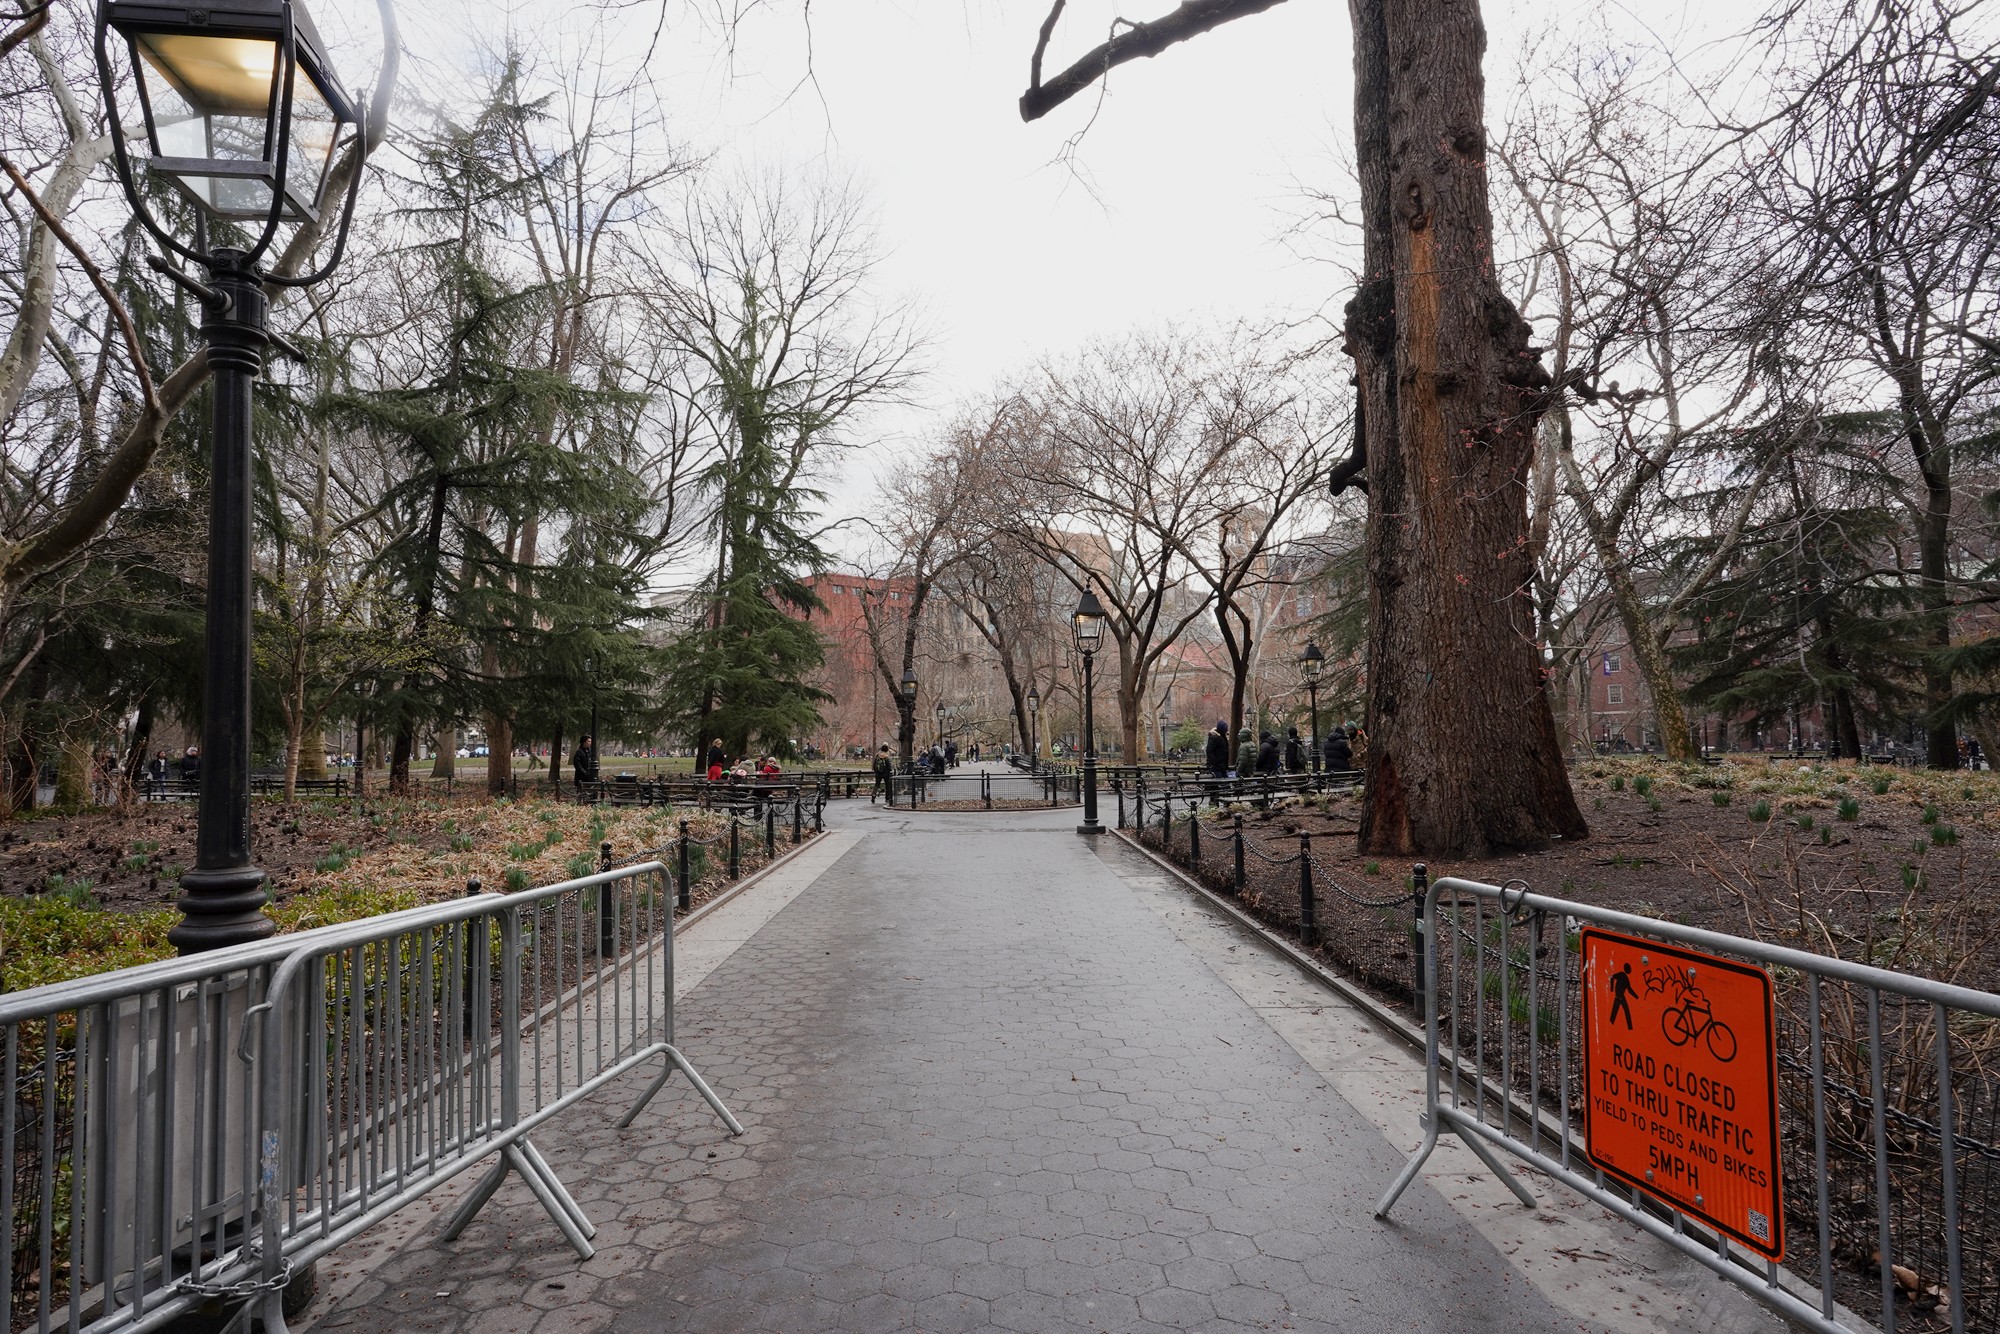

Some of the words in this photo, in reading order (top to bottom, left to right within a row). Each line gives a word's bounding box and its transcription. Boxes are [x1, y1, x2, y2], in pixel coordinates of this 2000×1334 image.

[1600, 1069, 1619, 1096] TO
[1625, 1078, 1669, 1118] THRU
[1675, 1100, 1755, 1156] TRAFFIC
[1613, 1043, 1656, 1079] ROAD
[1663, 1063, 1736, 1112] CLOSED
[1593, 1095, 1627, 1122] YIELD
[1631, 1111, 1646, 1132] TO
[1650, 1121, 1684, 1149] PEDS
[1688, 1139, 1718, 1164] AND
[1723, 1154, 1768, 1188] BIKES
[1648, 1145, 1699, 1190] 5MPH
